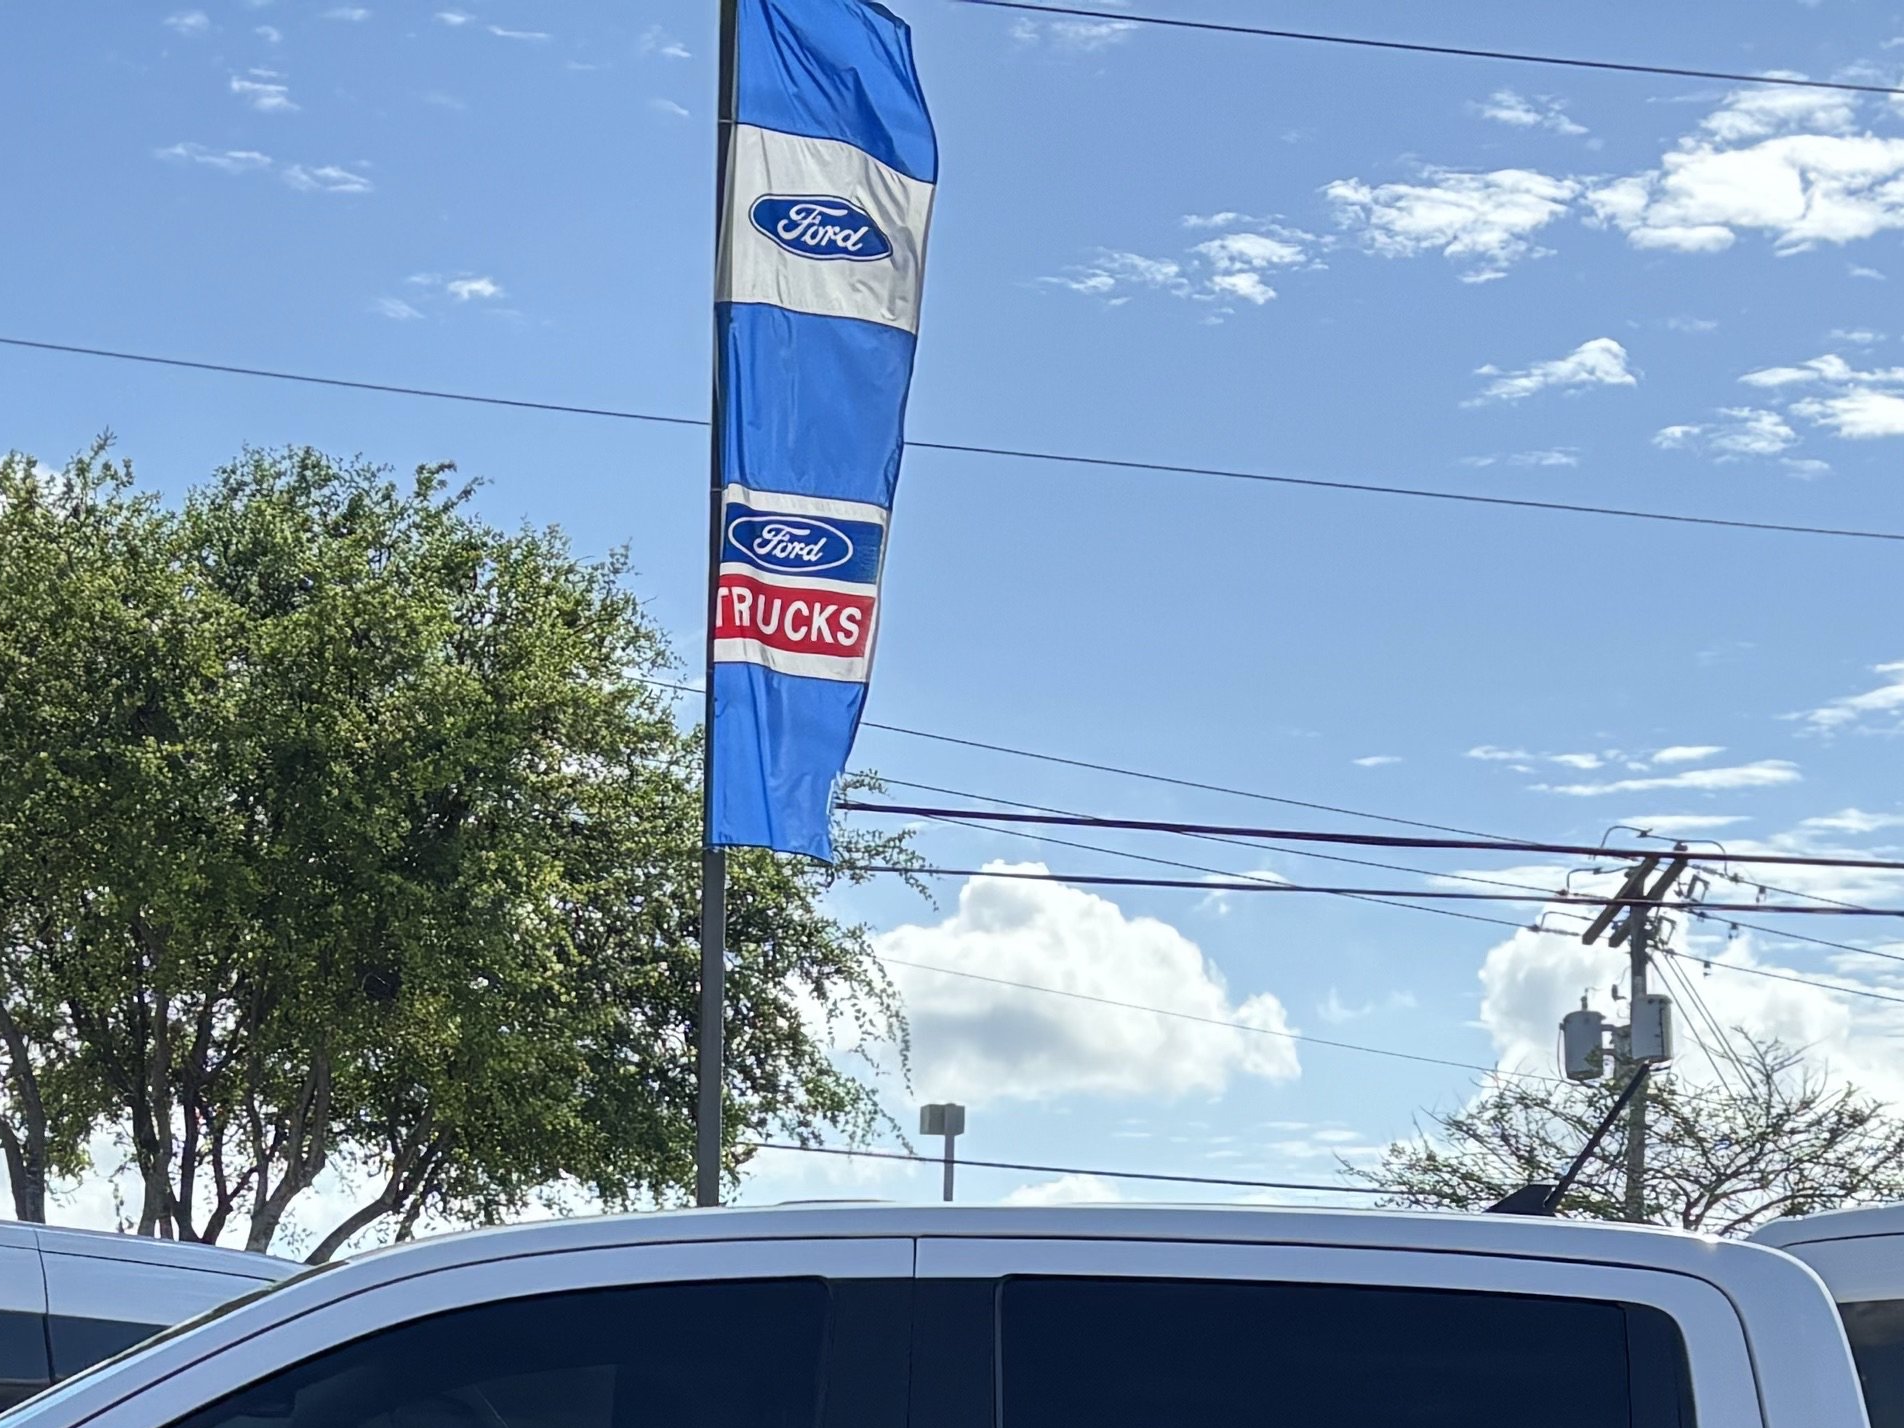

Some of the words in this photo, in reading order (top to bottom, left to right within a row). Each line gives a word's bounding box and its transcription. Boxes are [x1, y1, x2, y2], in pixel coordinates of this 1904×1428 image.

[777, 203, 868, 251] Ford
[752, 524, 827, 562] Ford
[715, 586, 862, 647] TRUCKS
